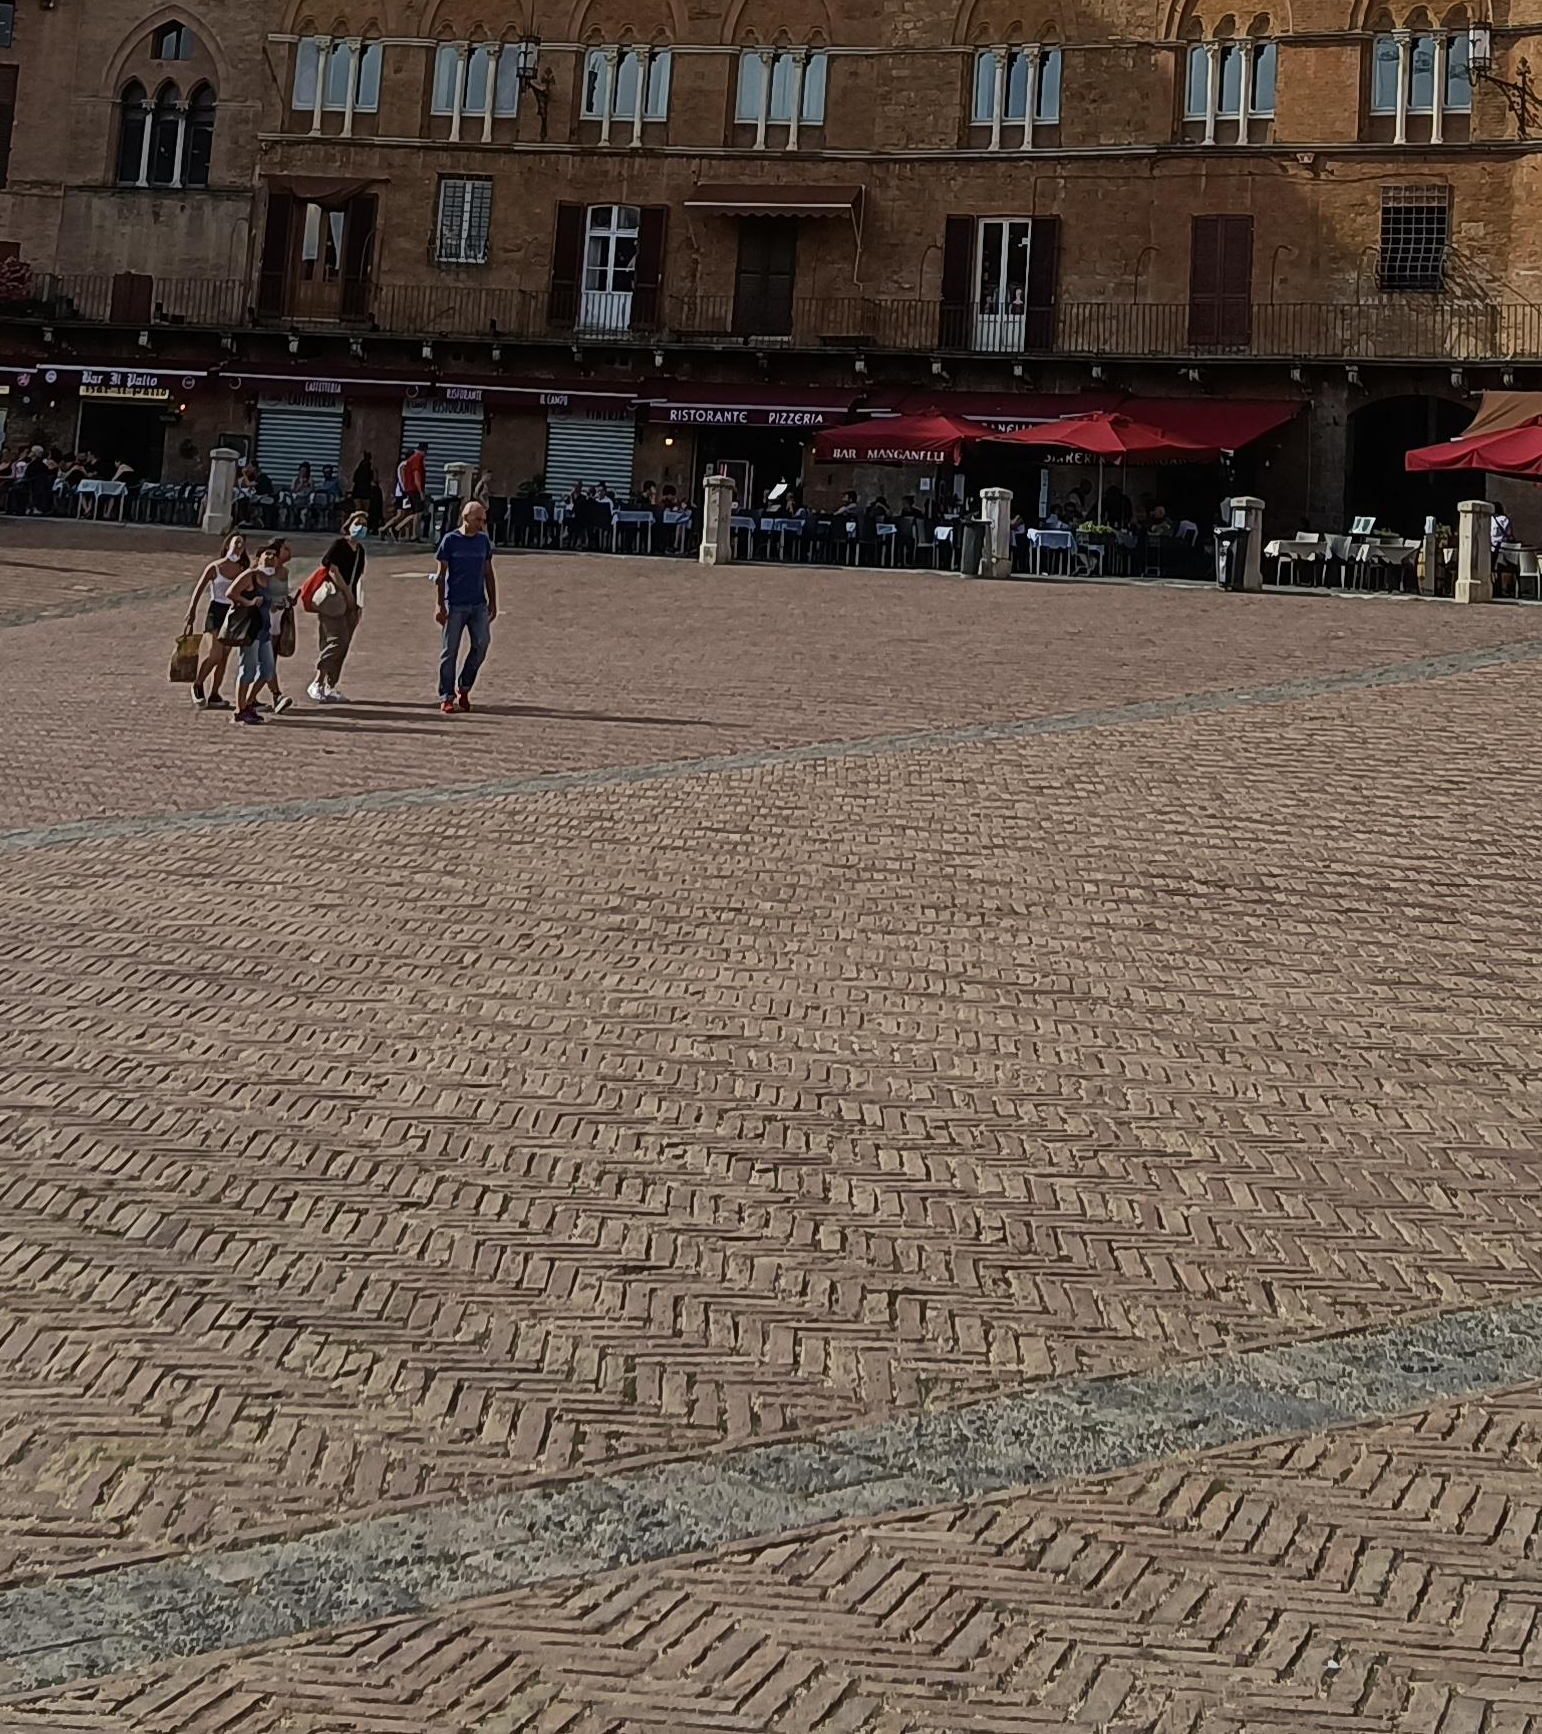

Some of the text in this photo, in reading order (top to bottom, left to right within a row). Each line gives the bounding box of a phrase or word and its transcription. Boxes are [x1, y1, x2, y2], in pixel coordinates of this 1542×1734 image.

[81, 370, 104, 384] Bar
[126, 373, 158, 387] Palio
[669, 409, 824, 425] RISTORANTE PIZZERIA
[832, 448, 945, 462] BAR MANGANELLI
